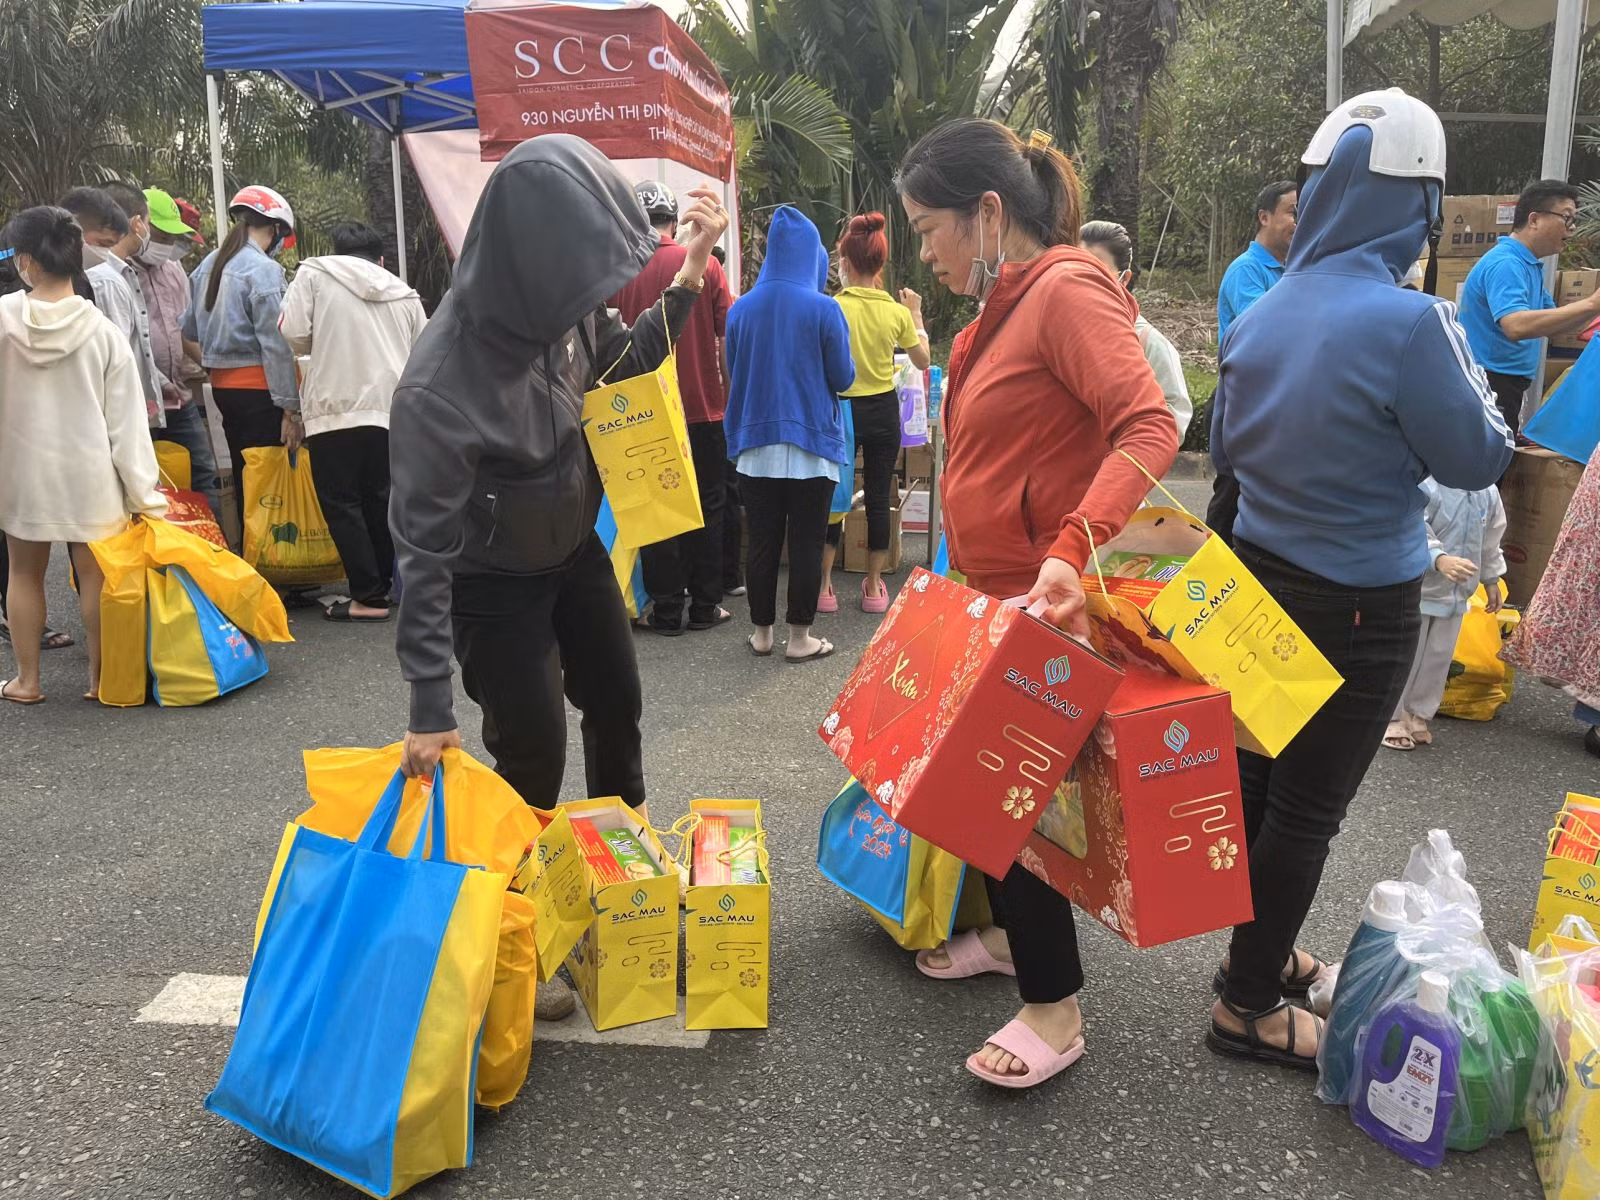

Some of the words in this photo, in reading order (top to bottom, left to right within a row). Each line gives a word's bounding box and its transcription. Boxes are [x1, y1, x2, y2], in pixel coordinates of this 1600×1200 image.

[546, 84, 585, 93] COSMETICS
[586, 80, 636, 90] CORPORATION
[521, 110, 549, 126] 930
[552, 101, 615, 124] NGUYỄN
[618, 104, 640, 121] THỊ
[597, 418, 623, 433] SAC
[626, 409, 654, 424] MAU
[1184, 607, 1209, 636] SAC
[1209, 577, 1236, 609] MAU
[883, 650, 919, 700] Xuân
[1003, 667, 1041, 696] SAC
[1041, 690, 1082, 719] MAU
[1138, 758, 1175, 778] SAC
[1180, 747, 1219, 768] MAU
[544, 843, 565, 867] MAU
[1554, 885, 1581, 898] SAC
[1584, 893, 1600, 904] MA
[611, 910, 636, 922] SAC
[639, 905, 666, 917] MAU
[699, 915, 723, 924] SAC
[727, 914, 755, 922] MAU
